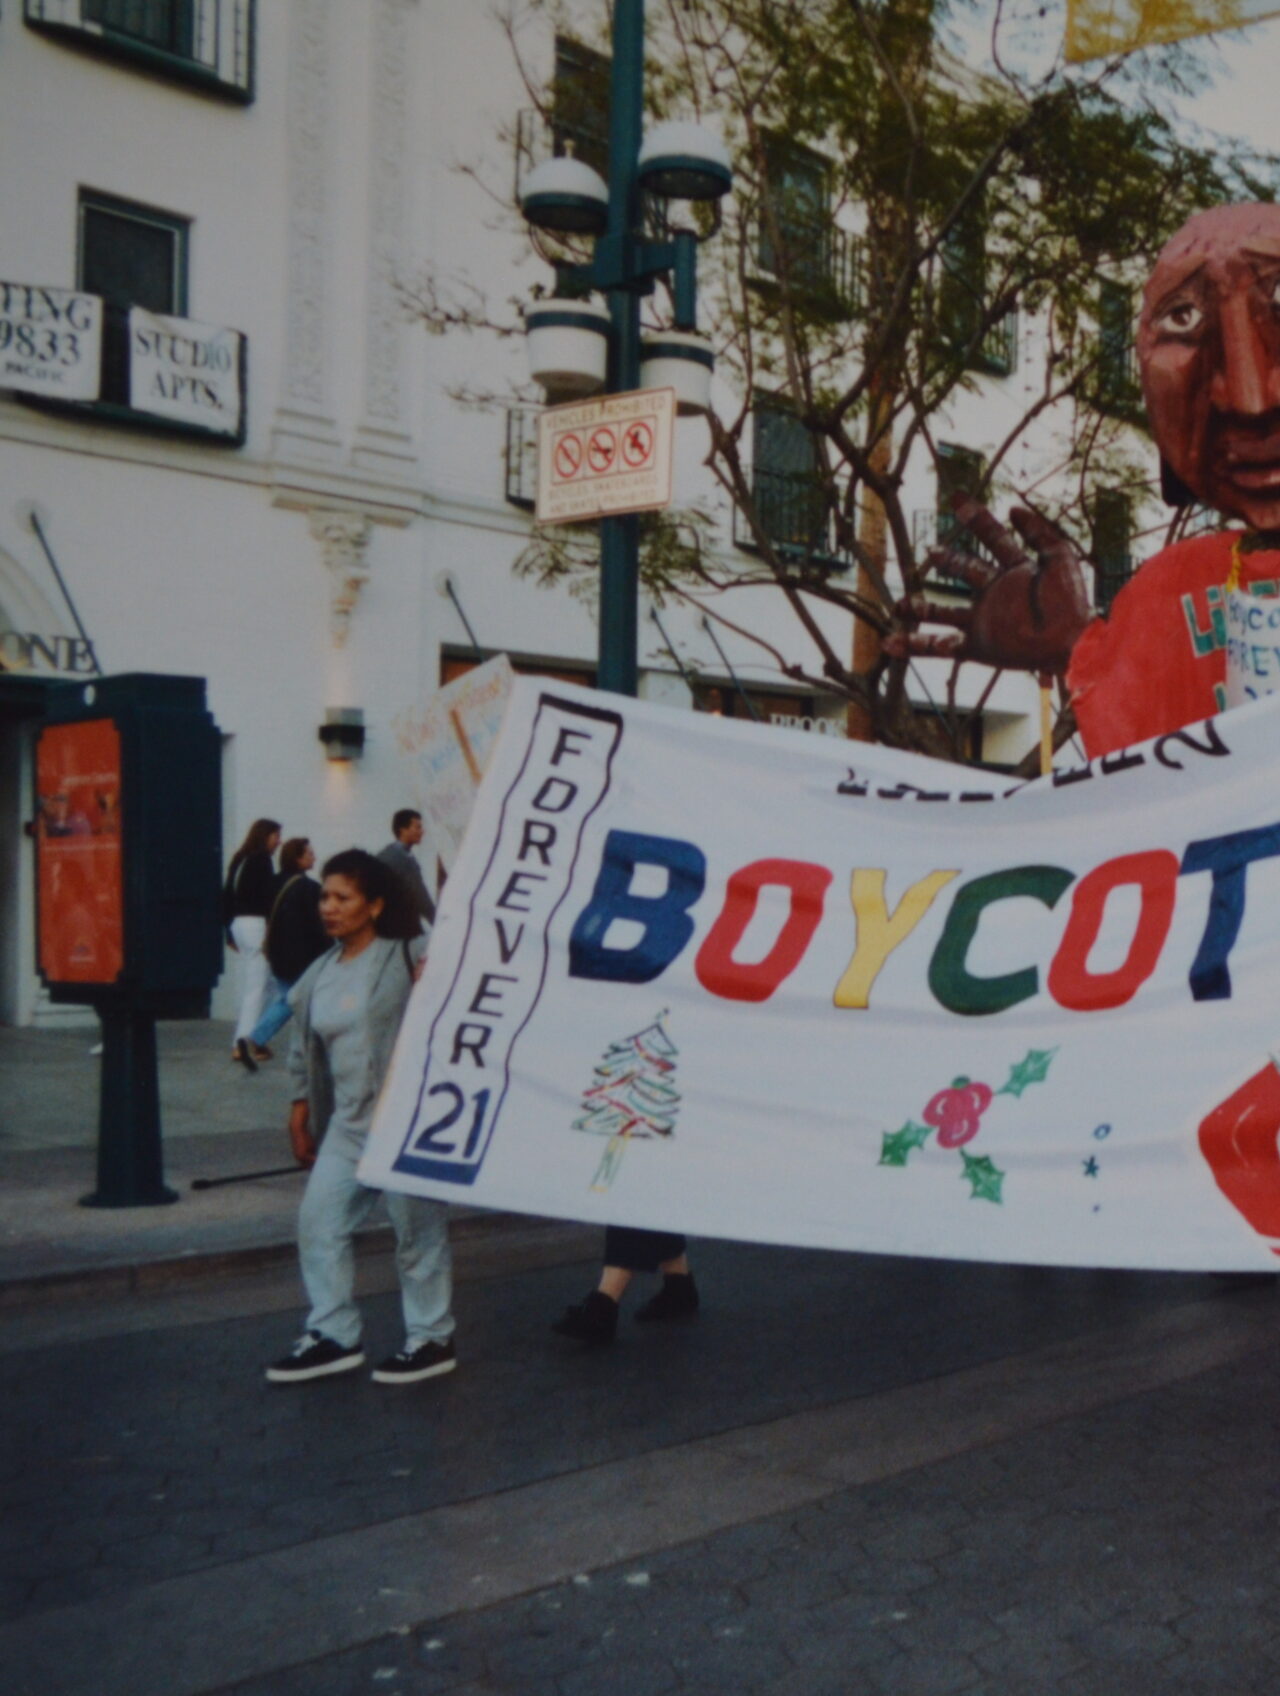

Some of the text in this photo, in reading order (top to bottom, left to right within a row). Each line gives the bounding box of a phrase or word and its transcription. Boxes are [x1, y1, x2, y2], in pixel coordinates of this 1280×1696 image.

[136, 328, 231, 373] STUDIO
[449, 727, 593, 1068] FOREVER
[415, 1081, 490, 1159] 21
